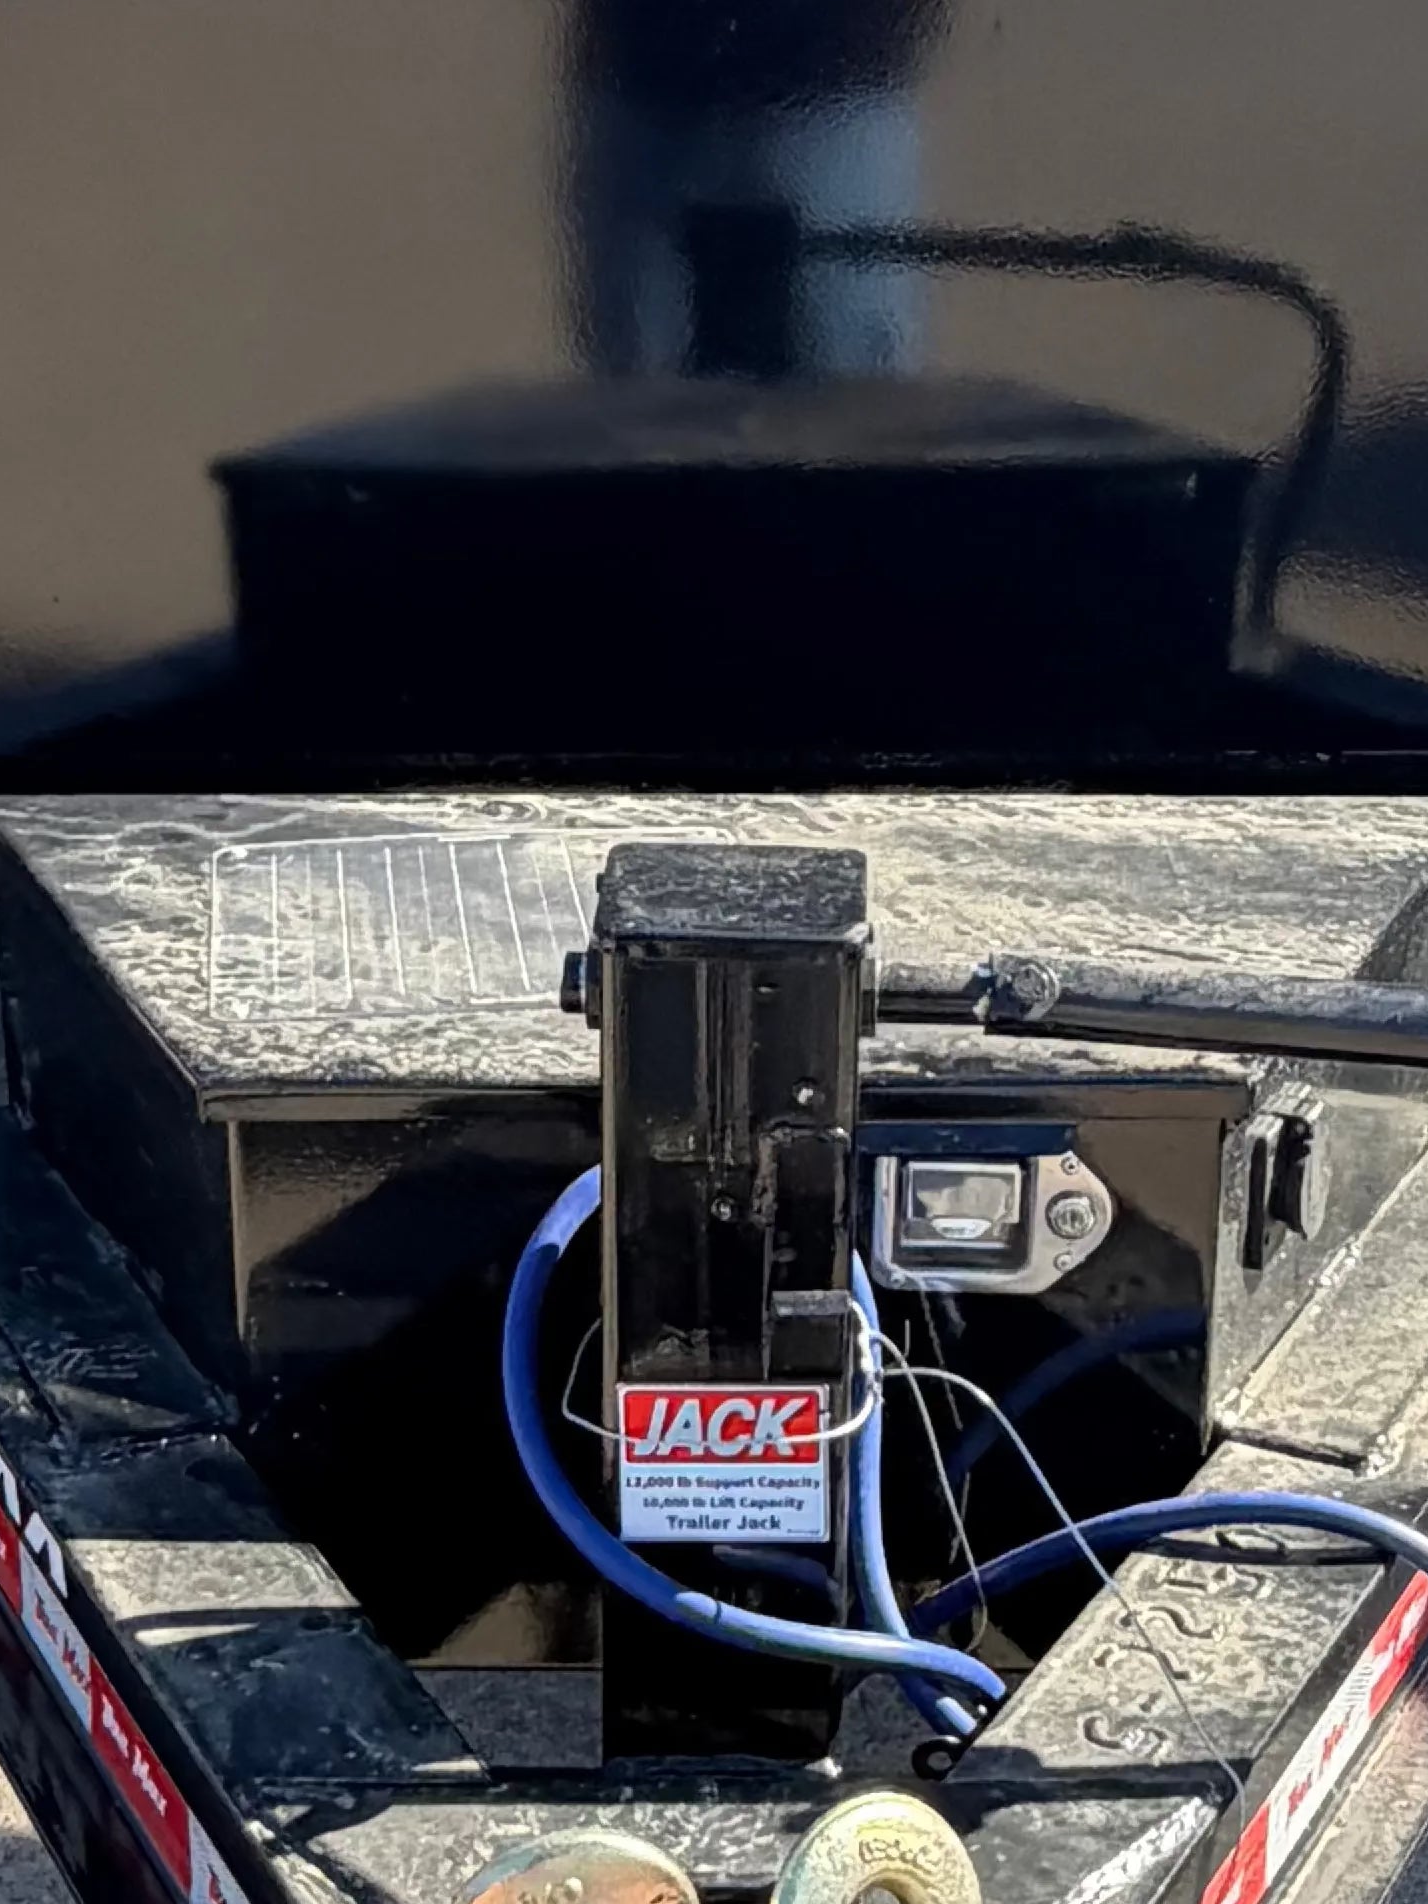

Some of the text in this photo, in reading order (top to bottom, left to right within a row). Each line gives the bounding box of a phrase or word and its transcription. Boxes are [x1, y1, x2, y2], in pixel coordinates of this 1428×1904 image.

[631, 1398, 809, 1456] JACK
[696, 1477, 753, 1490] Support
[759, 1476, 820, 1490] Capacity
[711, 1497, 736, 1508] Lift
[740, 1497, 805, 1511] Capacity
[666, 1515, 781, 1530] Trailer Jack
